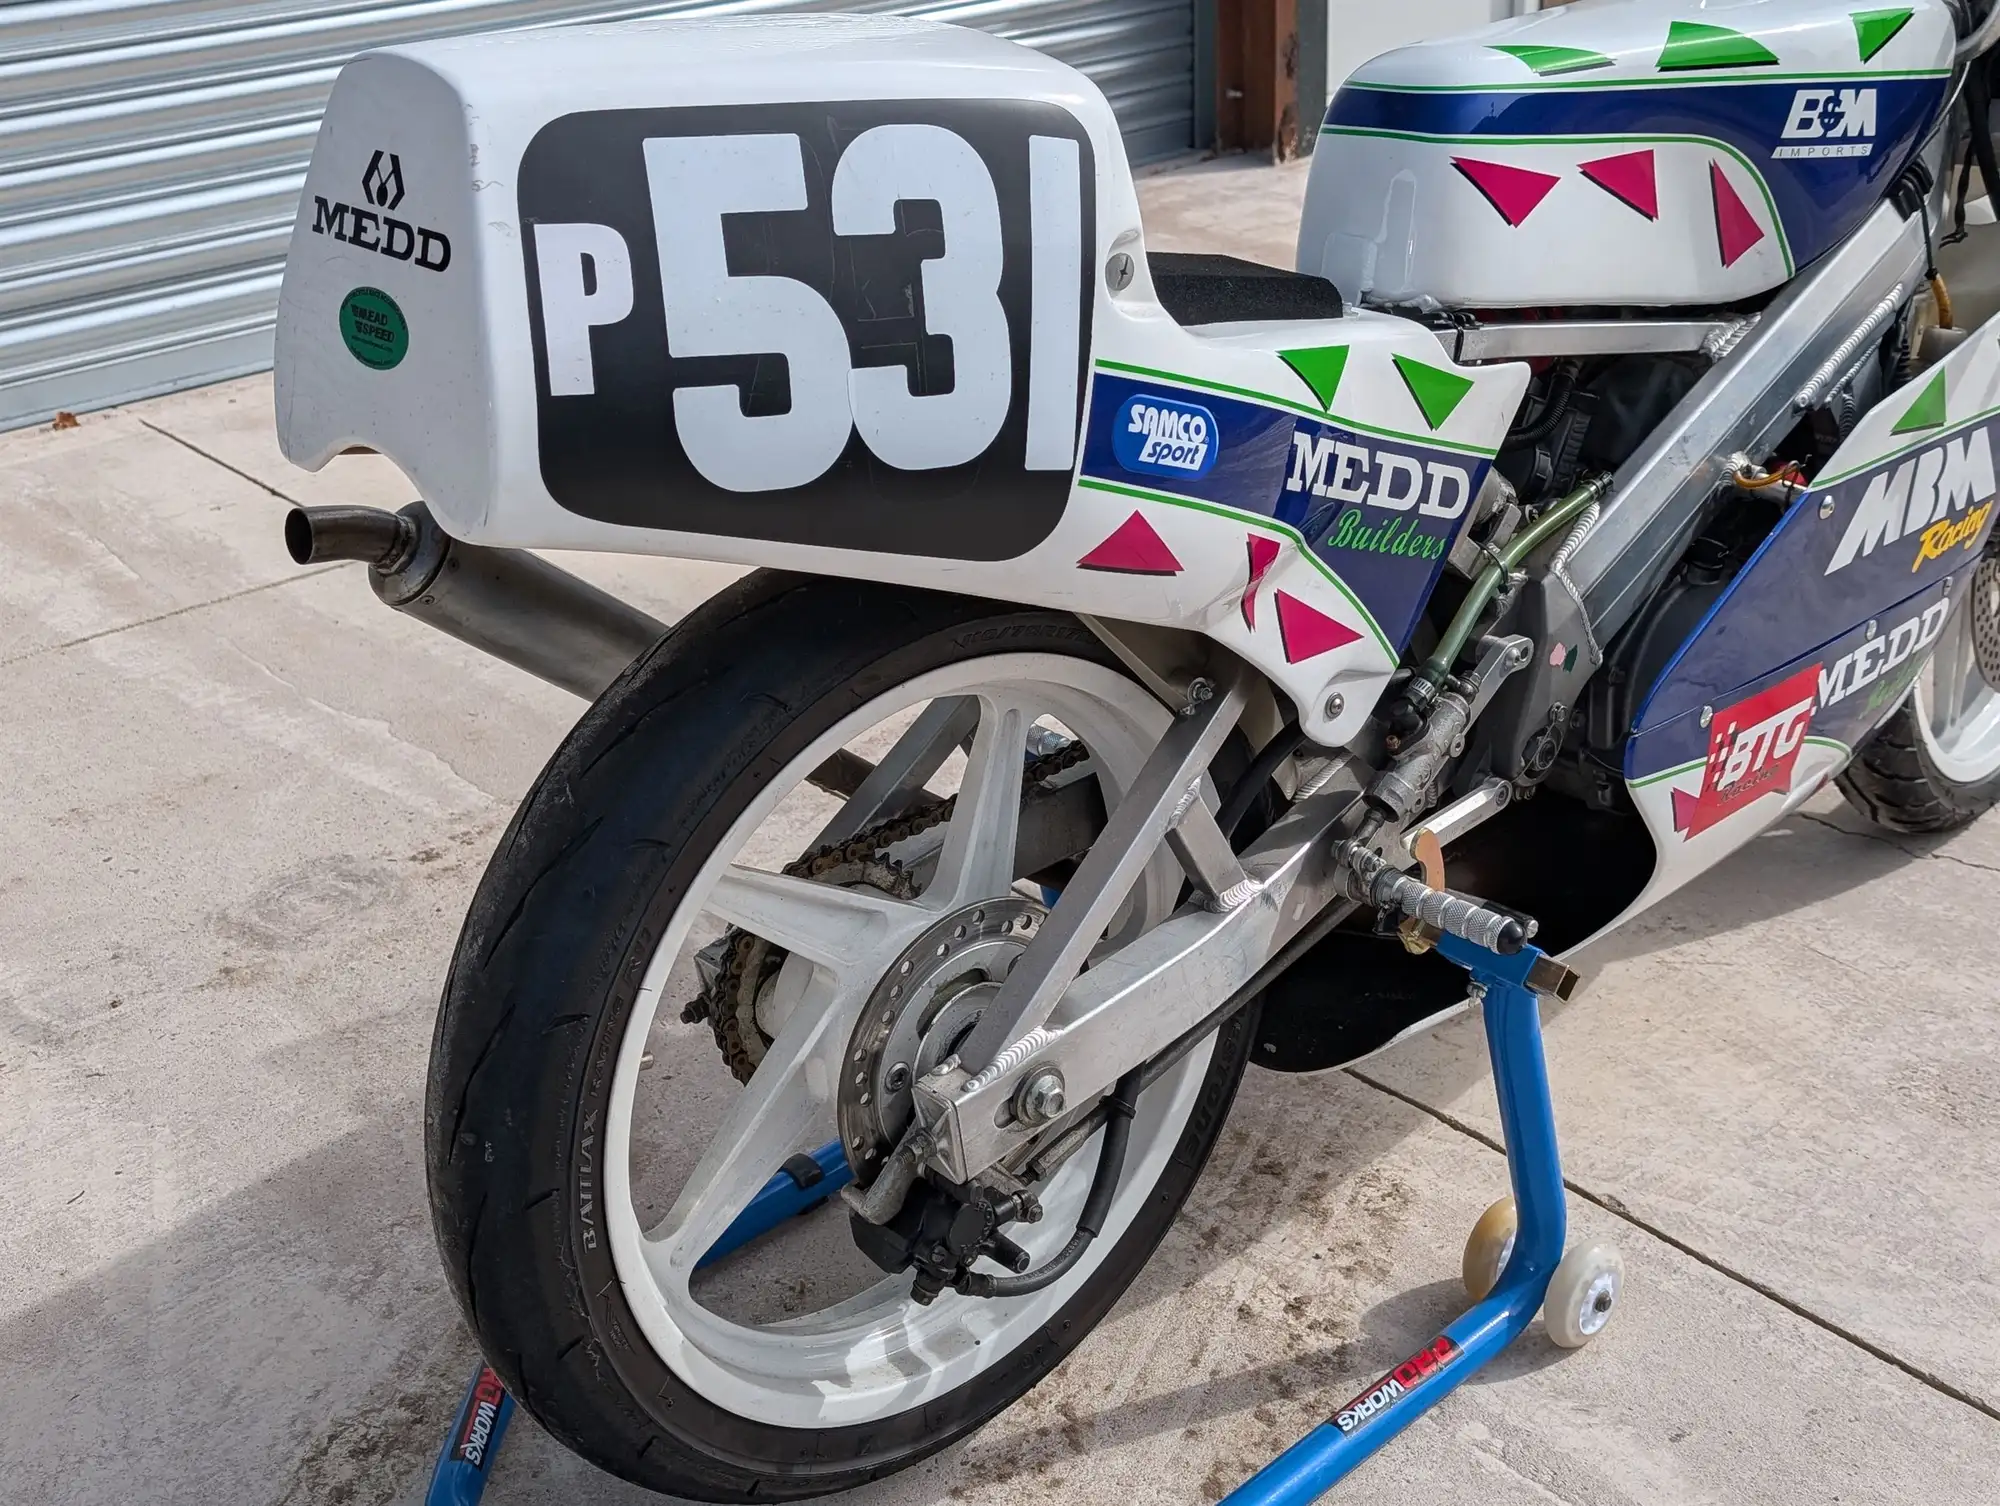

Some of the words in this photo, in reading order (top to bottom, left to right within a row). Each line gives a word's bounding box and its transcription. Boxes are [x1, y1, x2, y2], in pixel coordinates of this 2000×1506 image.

[1778, 145, 1868, 158] IMPORTS
[311, 195, 452, 273] MEDD
[357, 307, 389, 326] MEAD
[363, 322, 395, 343] SPEED
[533, 223, 634, 396] P
[643, 124, 1082, 493] 531
[1127, 403, 1208, 445] SAMCO
[1146, 438, 1200, 468] sport
[1286, 430, 1471, 520] MEDD
[1824, 426, 1997, 577] MBM
[1327, 507, 1447, 561] Builders
[1911, 499, 1994, 574] Racing
[1811, 597, 1950, 716] MEDD
[579, 1108, 599, 1254] BATTLAX
